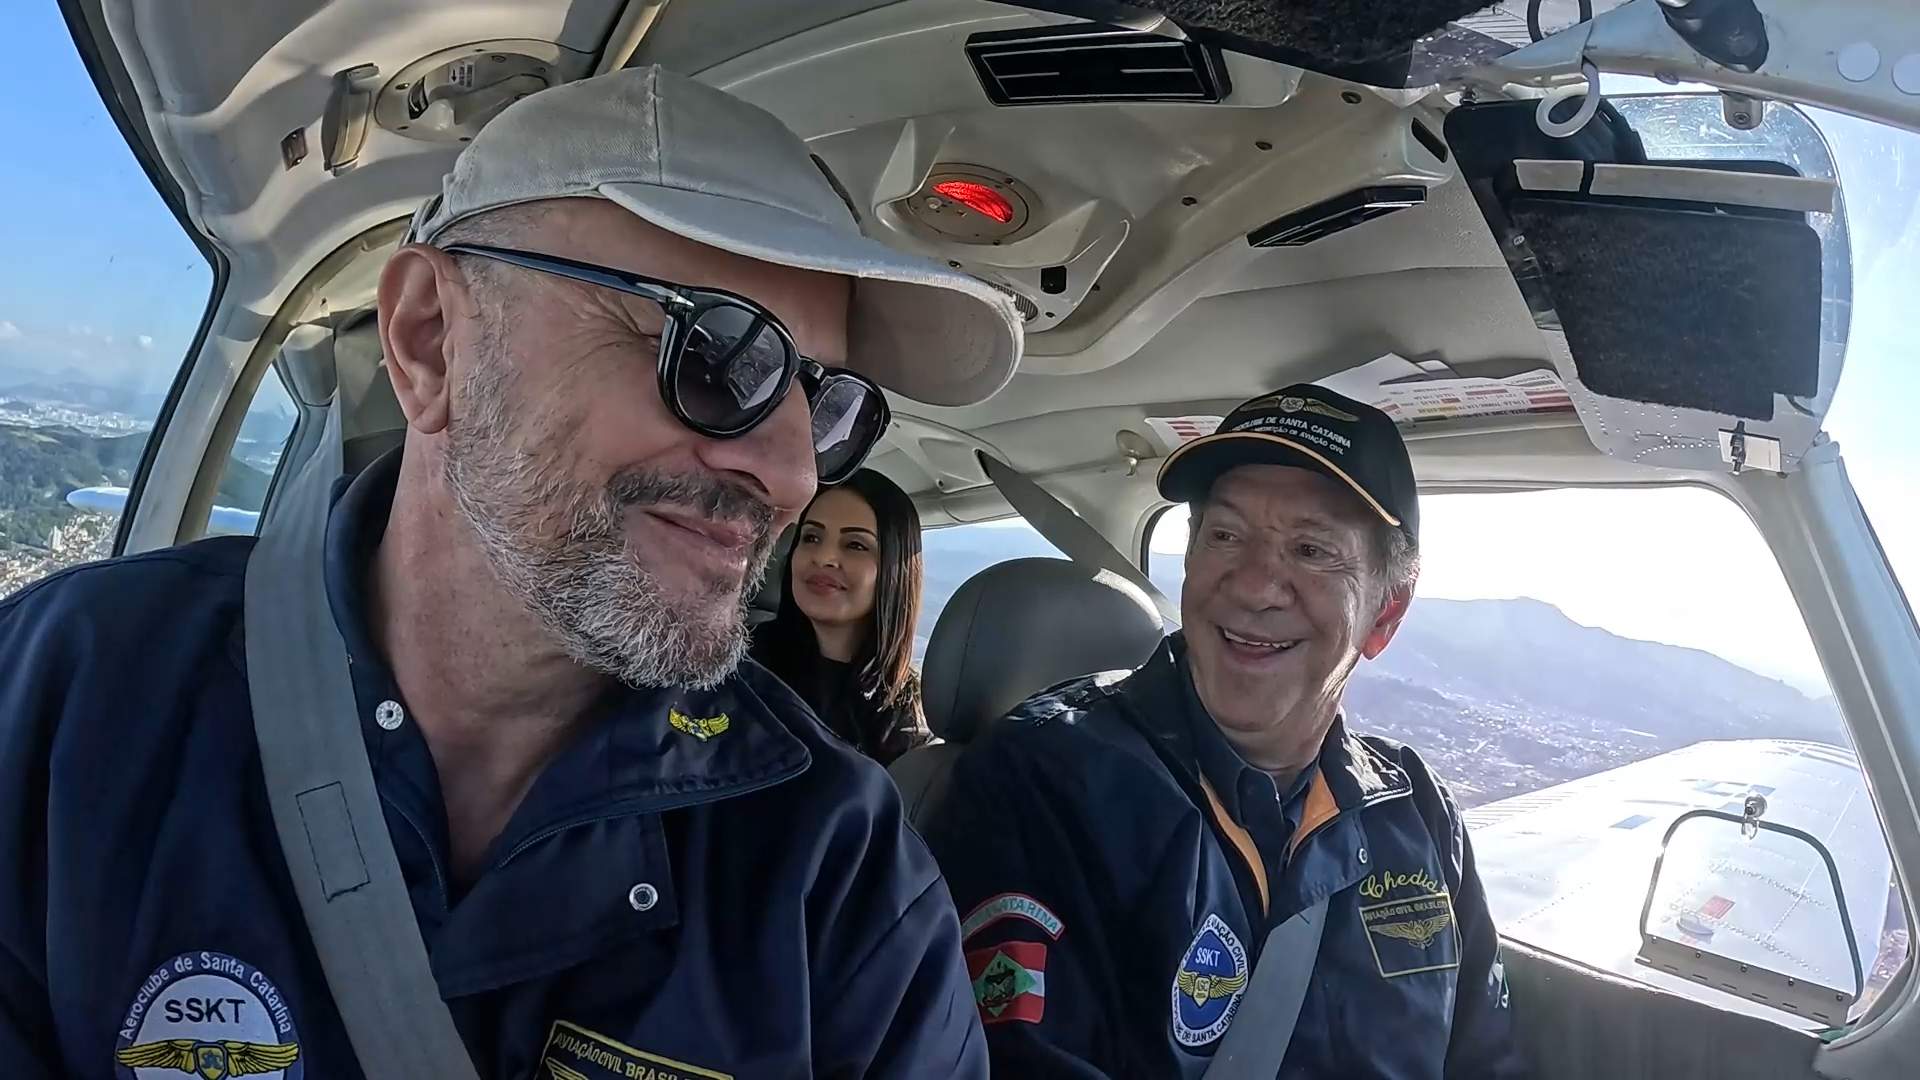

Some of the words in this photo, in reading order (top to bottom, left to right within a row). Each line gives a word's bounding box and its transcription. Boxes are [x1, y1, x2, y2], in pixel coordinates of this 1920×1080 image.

[1265, 416, 1278, 424] DE
[1279, 417, 1308, 430] SANTA
[1310, 424, 1352, 449] CATARINA
[1195, 946, 1221, 967] SSKT
[1232, 946, 1245, 974] CIVIL
[119, 968, 170, 1041] Aeroclube
[174, 956, 193, 973] de
[200, 951, 245, 979] Santa
[249, 971, 292, 1034] Catarina
[164, 997, 246, 1024] SSKT
[1191, 1029, 1217, 1043] SANTA
[553, 1032, 600, 1062] AVIAÇÃO
[597, 1050, 622, 1075] CIVIL
